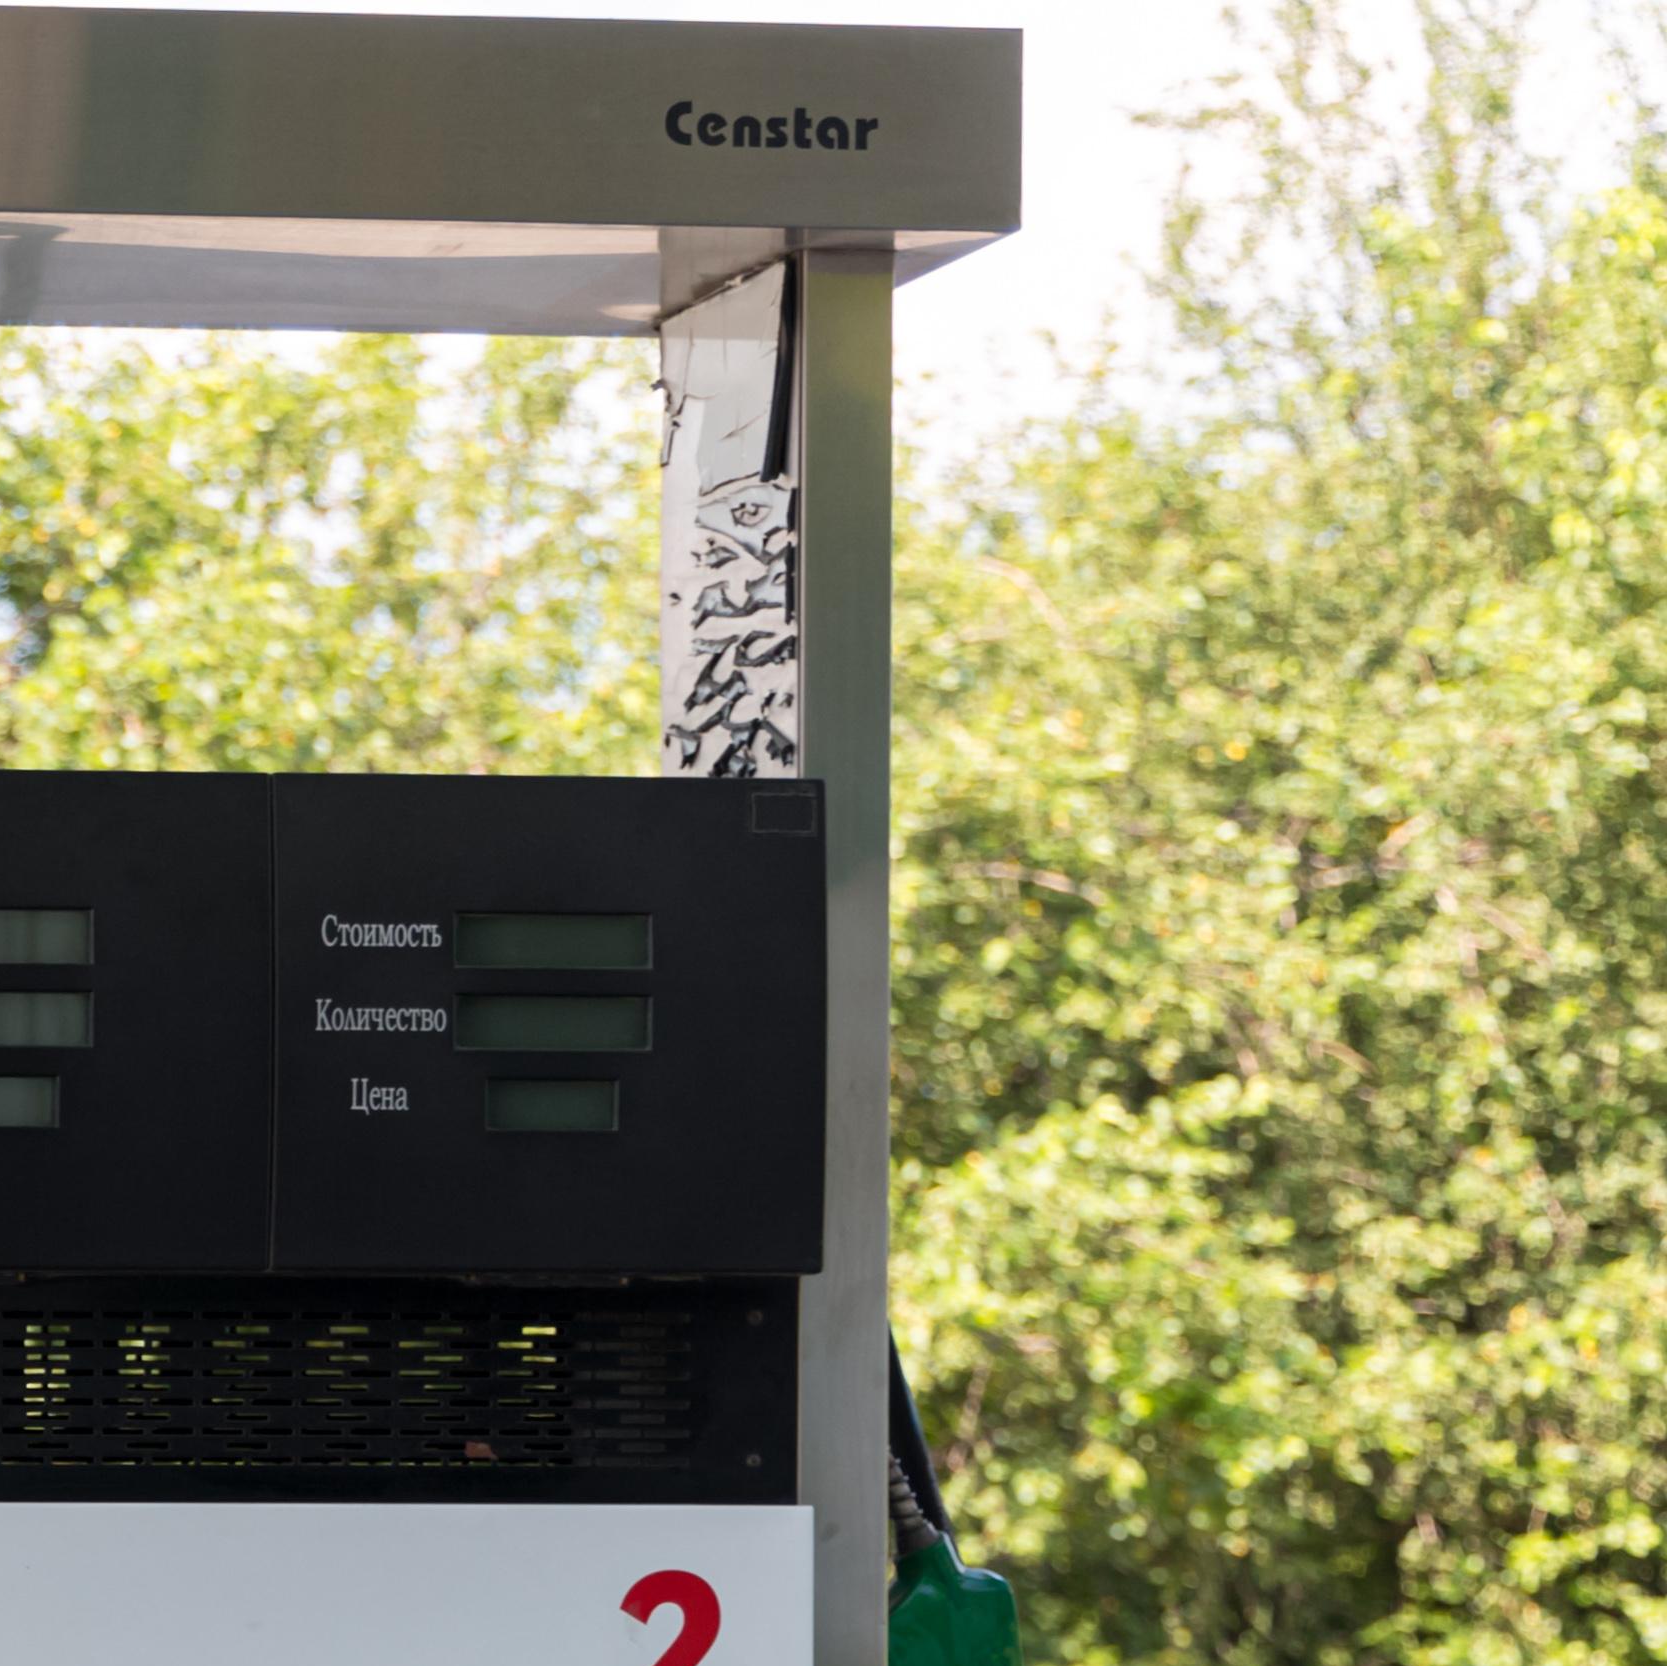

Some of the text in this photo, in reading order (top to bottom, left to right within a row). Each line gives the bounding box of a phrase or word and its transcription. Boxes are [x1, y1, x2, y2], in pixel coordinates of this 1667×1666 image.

[667, 99, 880, 152] Censtar
[321, 913, 443, 948] Стоимость
[315, 998, 448, 1033] Количество
[349, 1077, 410, 1116] Цена
